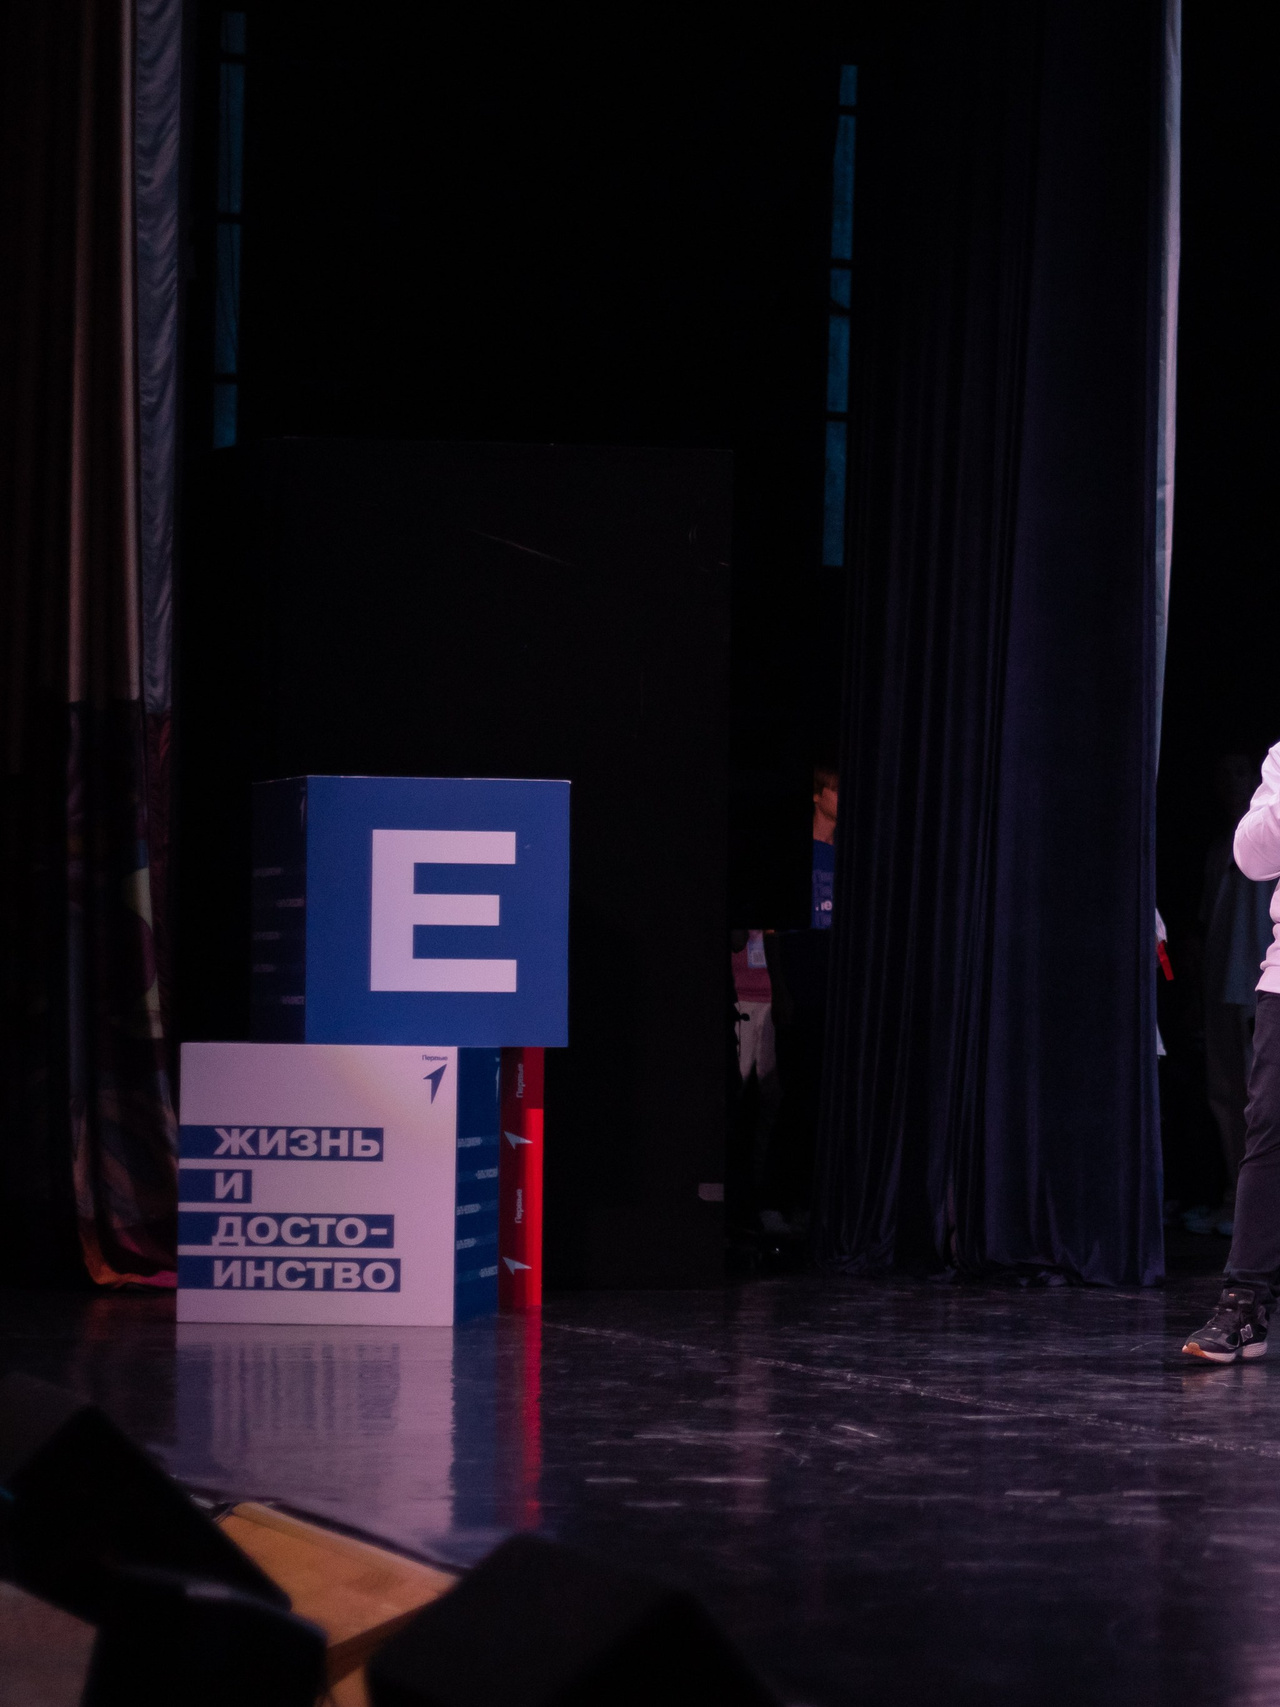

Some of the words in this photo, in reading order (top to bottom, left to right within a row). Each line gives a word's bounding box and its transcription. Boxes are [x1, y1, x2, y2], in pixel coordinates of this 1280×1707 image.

[213, 1128, 381, 1158] ЖИЗНЬ
[214, 1172, 244, 1200] И
[211, 1216, 388, 1247] ДОСТО-
[213, 1260, 396, 1291] ИНСТВО
